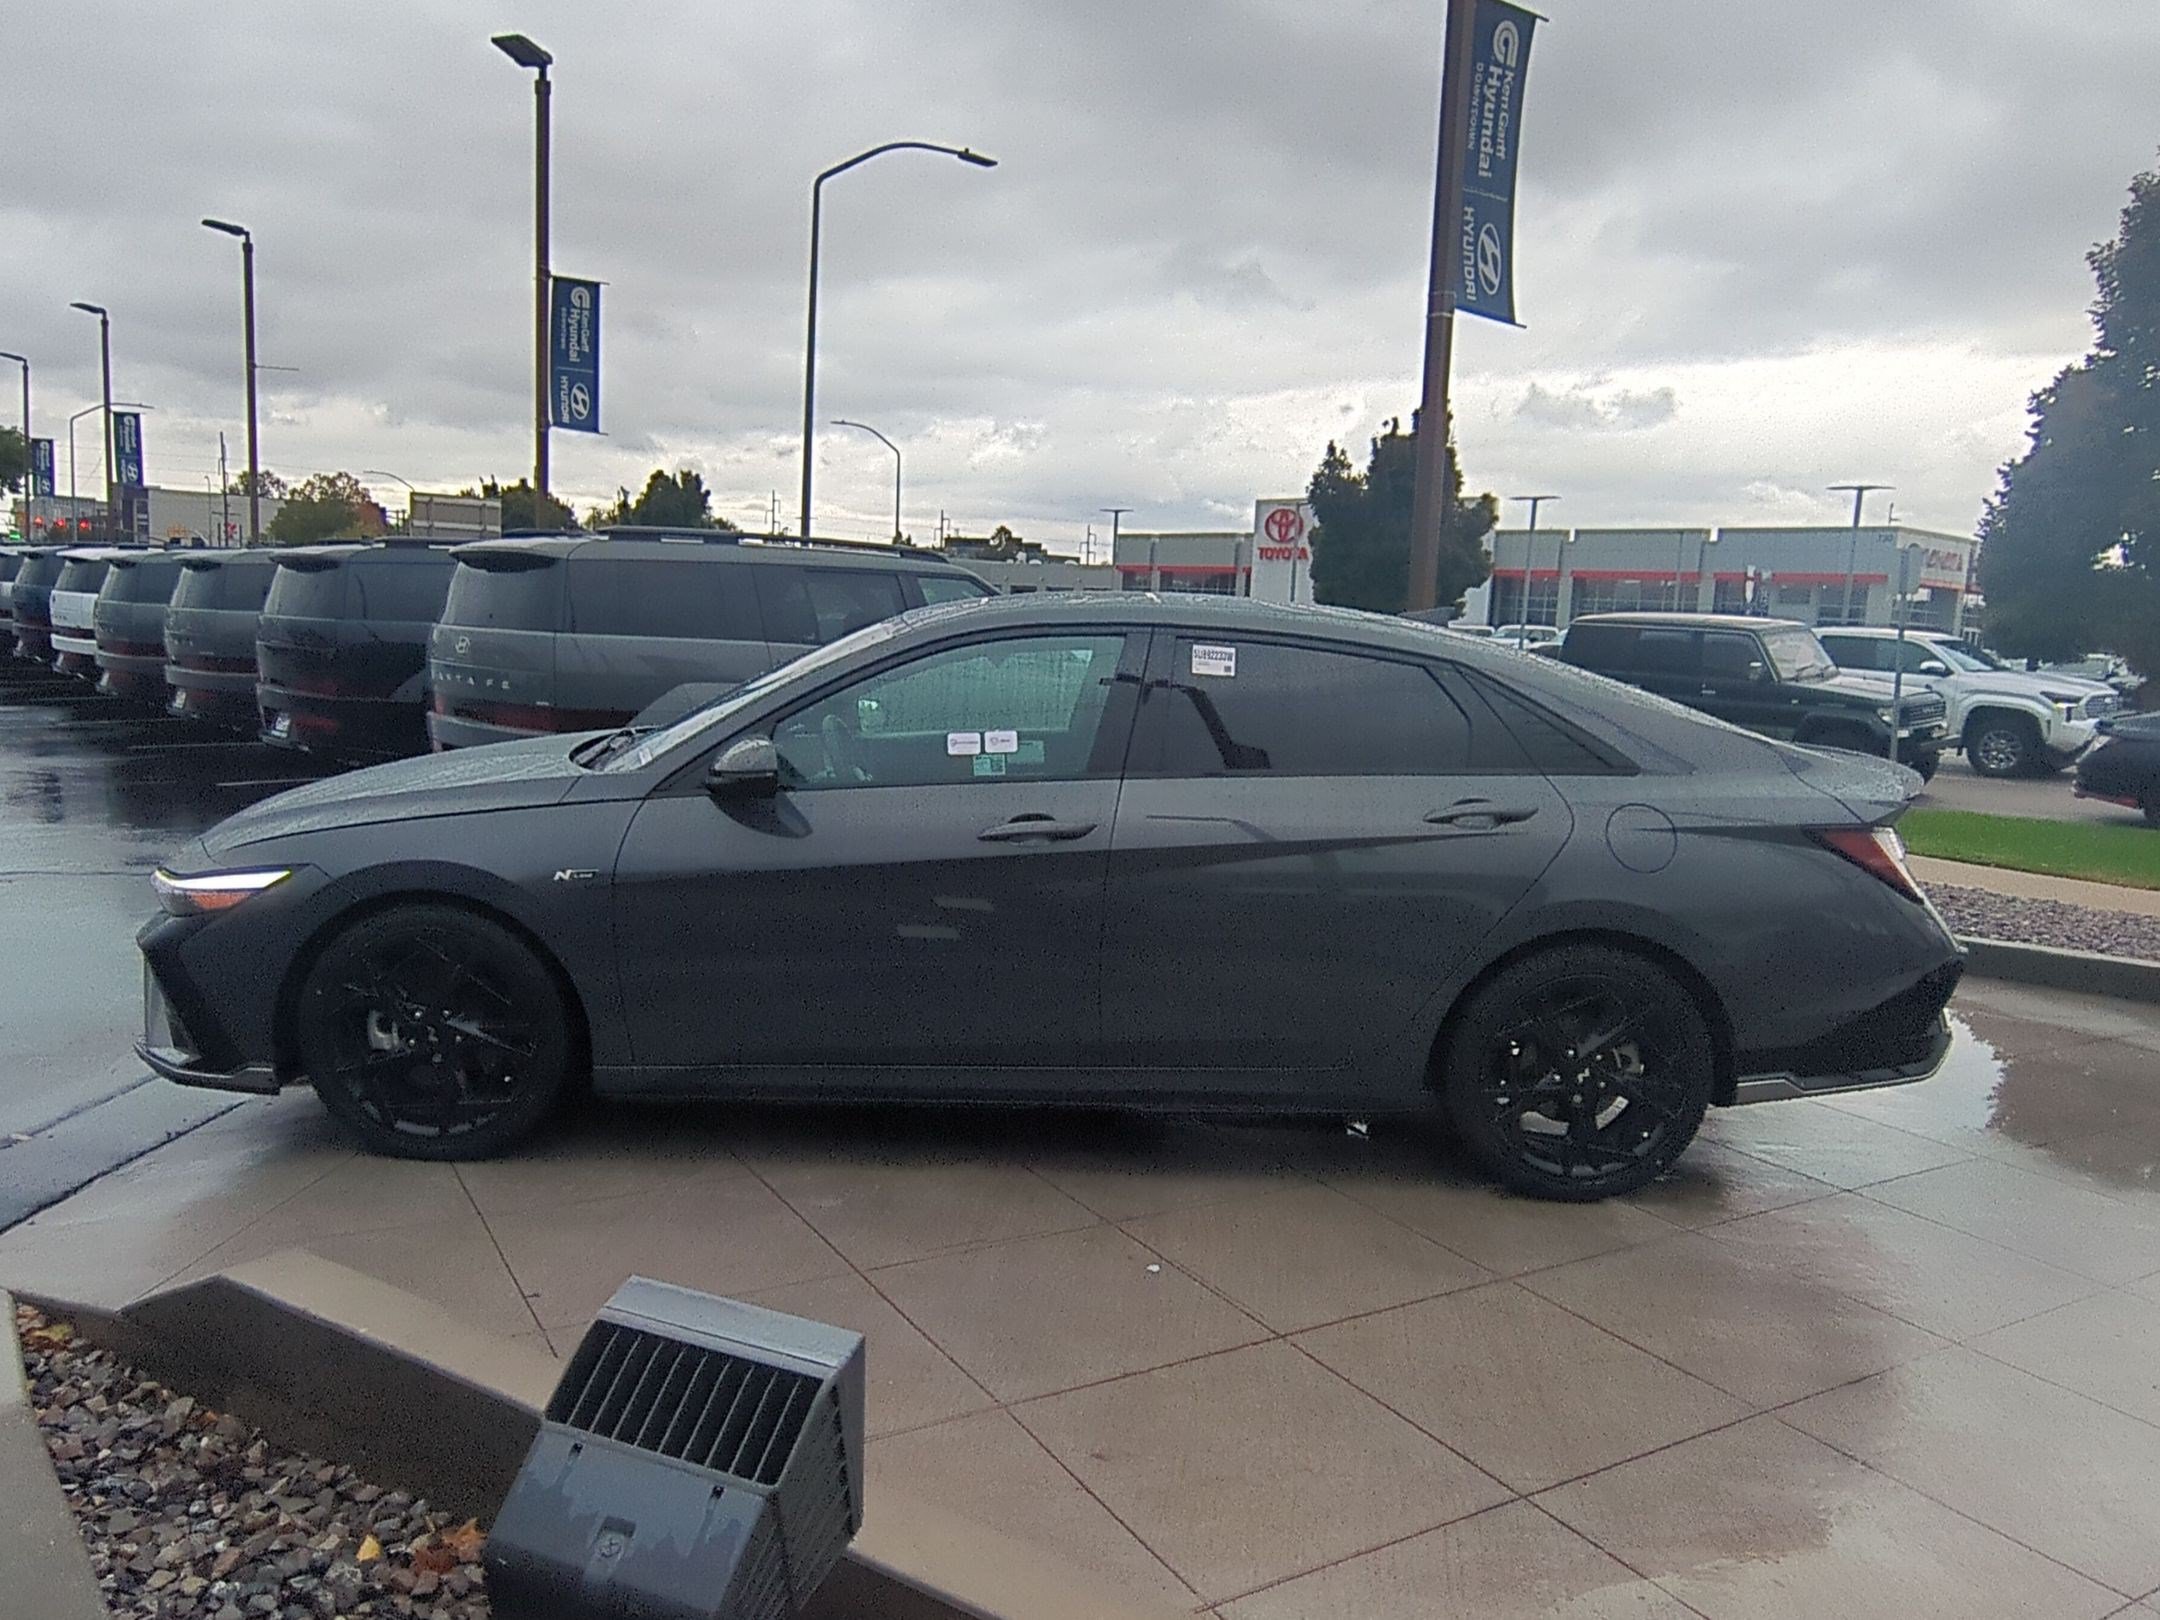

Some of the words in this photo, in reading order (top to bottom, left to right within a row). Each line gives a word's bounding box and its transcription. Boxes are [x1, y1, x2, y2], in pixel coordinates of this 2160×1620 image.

[1468, 62, 1484, 149] DOWNTOWN
[1501, 70, 1515, 109] Ken
[1478, 65, 1503, 178] Hyundai
[1496, 112, 1510, 160] Garff
[1463, 206, 1477, 301] HYUNDAI
[568, 308, 581, 362] Hyundai
[560, 375, 570, 424] HYUNDAI
